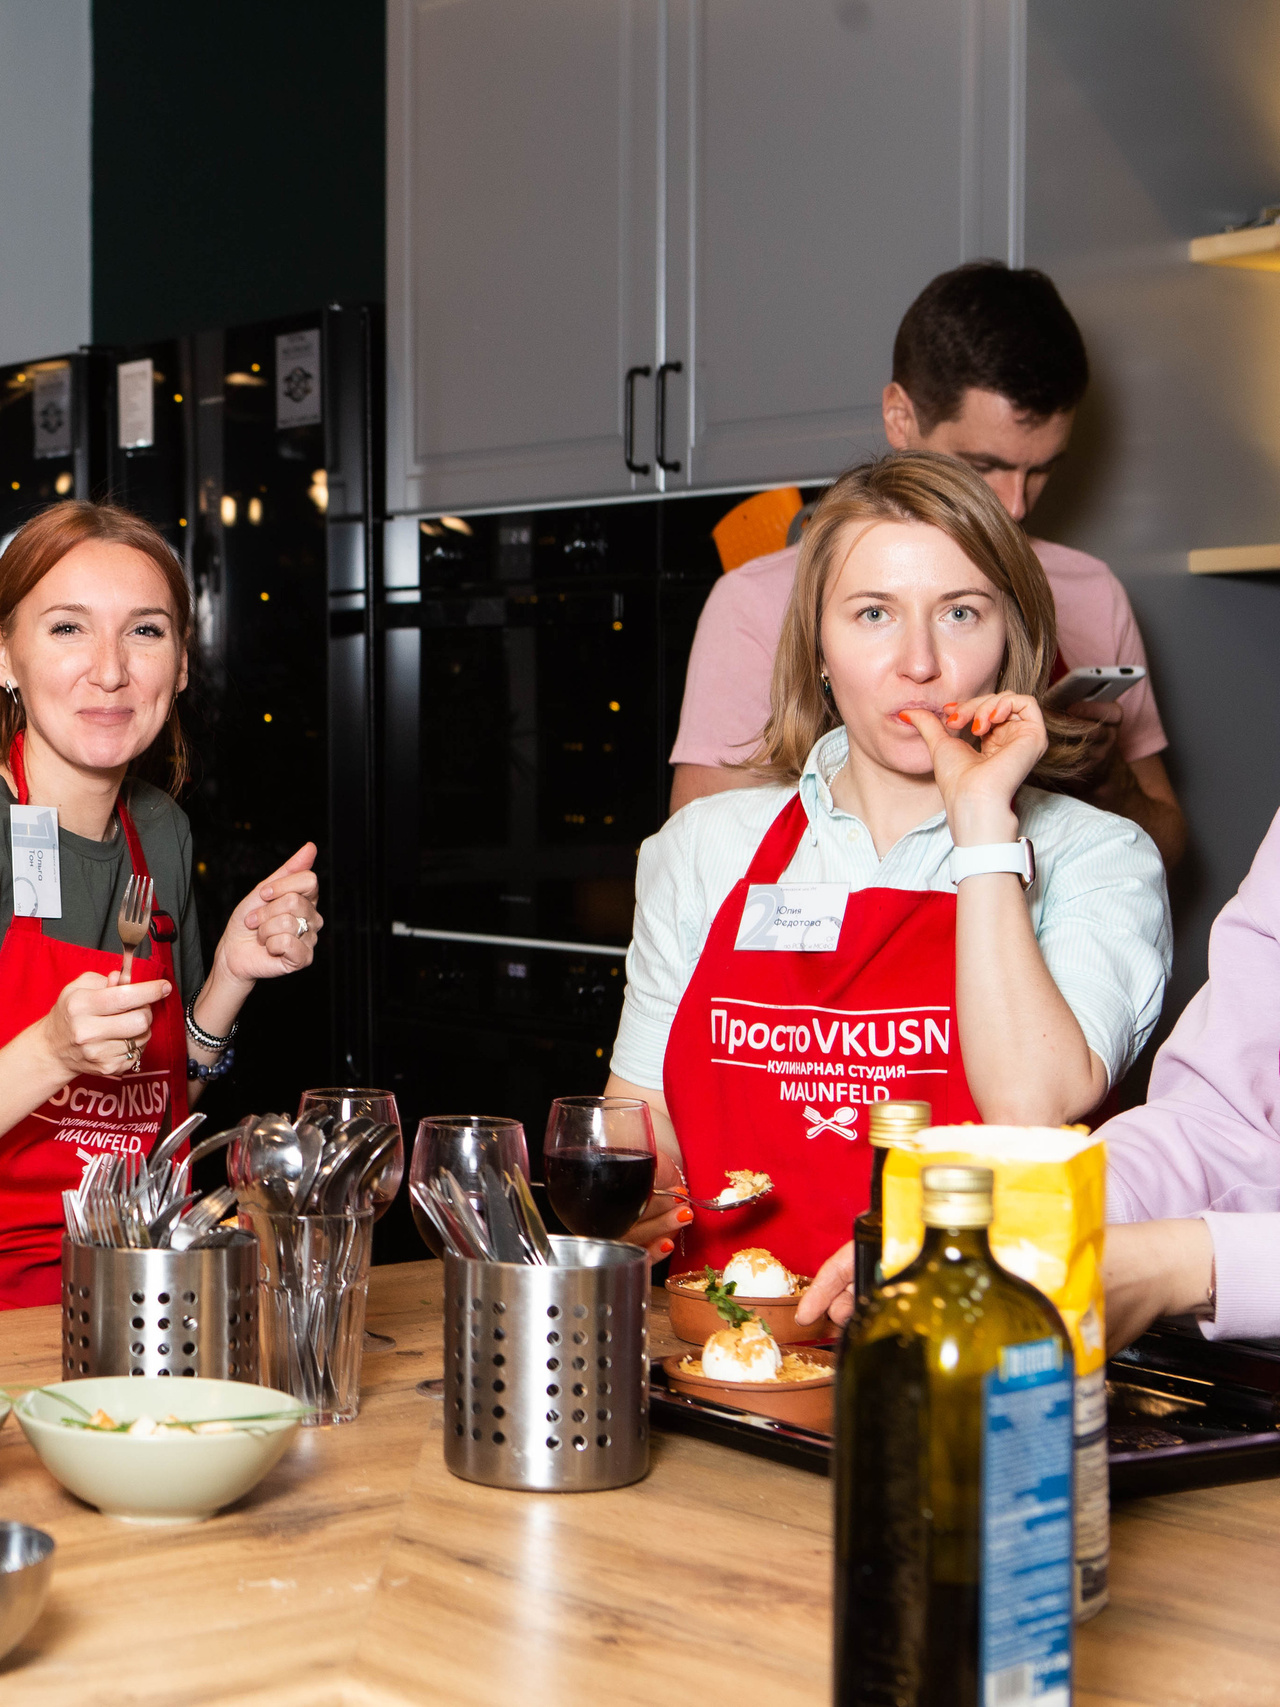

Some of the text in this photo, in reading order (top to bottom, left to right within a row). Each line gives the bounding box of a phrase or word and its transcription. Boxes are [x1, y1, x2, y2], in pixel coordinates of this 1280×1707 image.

[773, 918, 822, 928] Федотова
[767, 1060, 906, 1081] КУЛИНАРНАЯ СТУДИЯ
[780, 1081, 890, 1104] MAUNFELD
[58, 1117, 159, 1134] КУЛИНАРНАЯ СТУДИЯ
[54, 1128, 142, 1153] MAUNFELD
